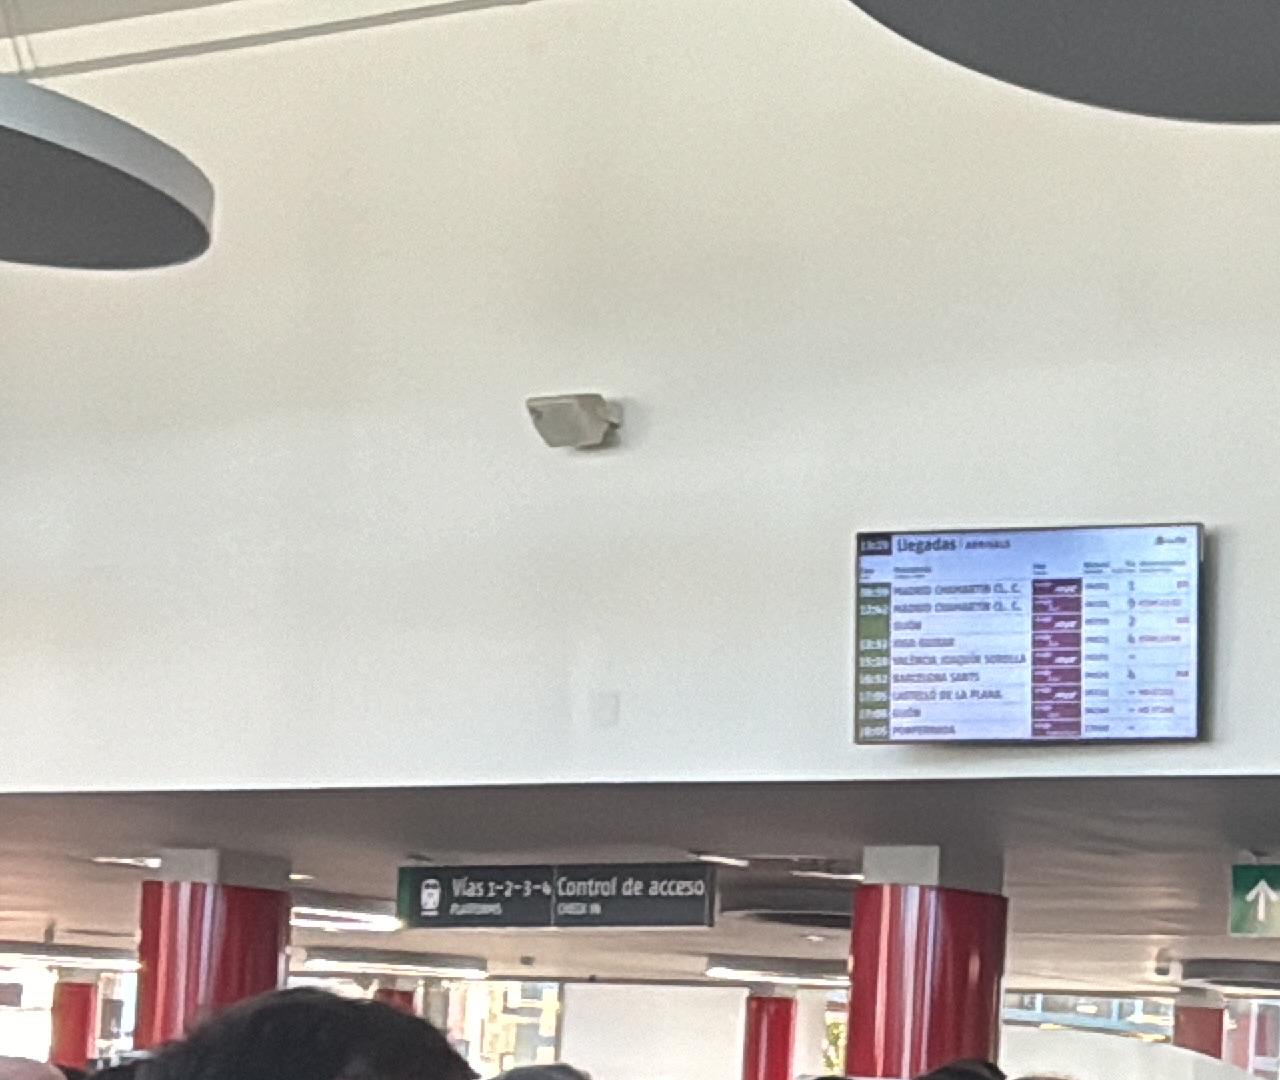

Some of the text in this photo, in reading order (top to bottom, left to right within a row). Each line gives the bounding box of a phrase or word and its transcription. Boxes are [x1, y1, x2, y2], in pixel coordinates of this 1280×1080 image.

[897, 538, 956, 554] Llegadas
[452, 876, 484, 898] Vías
[557, 876, 705, 897] Control de acceso
